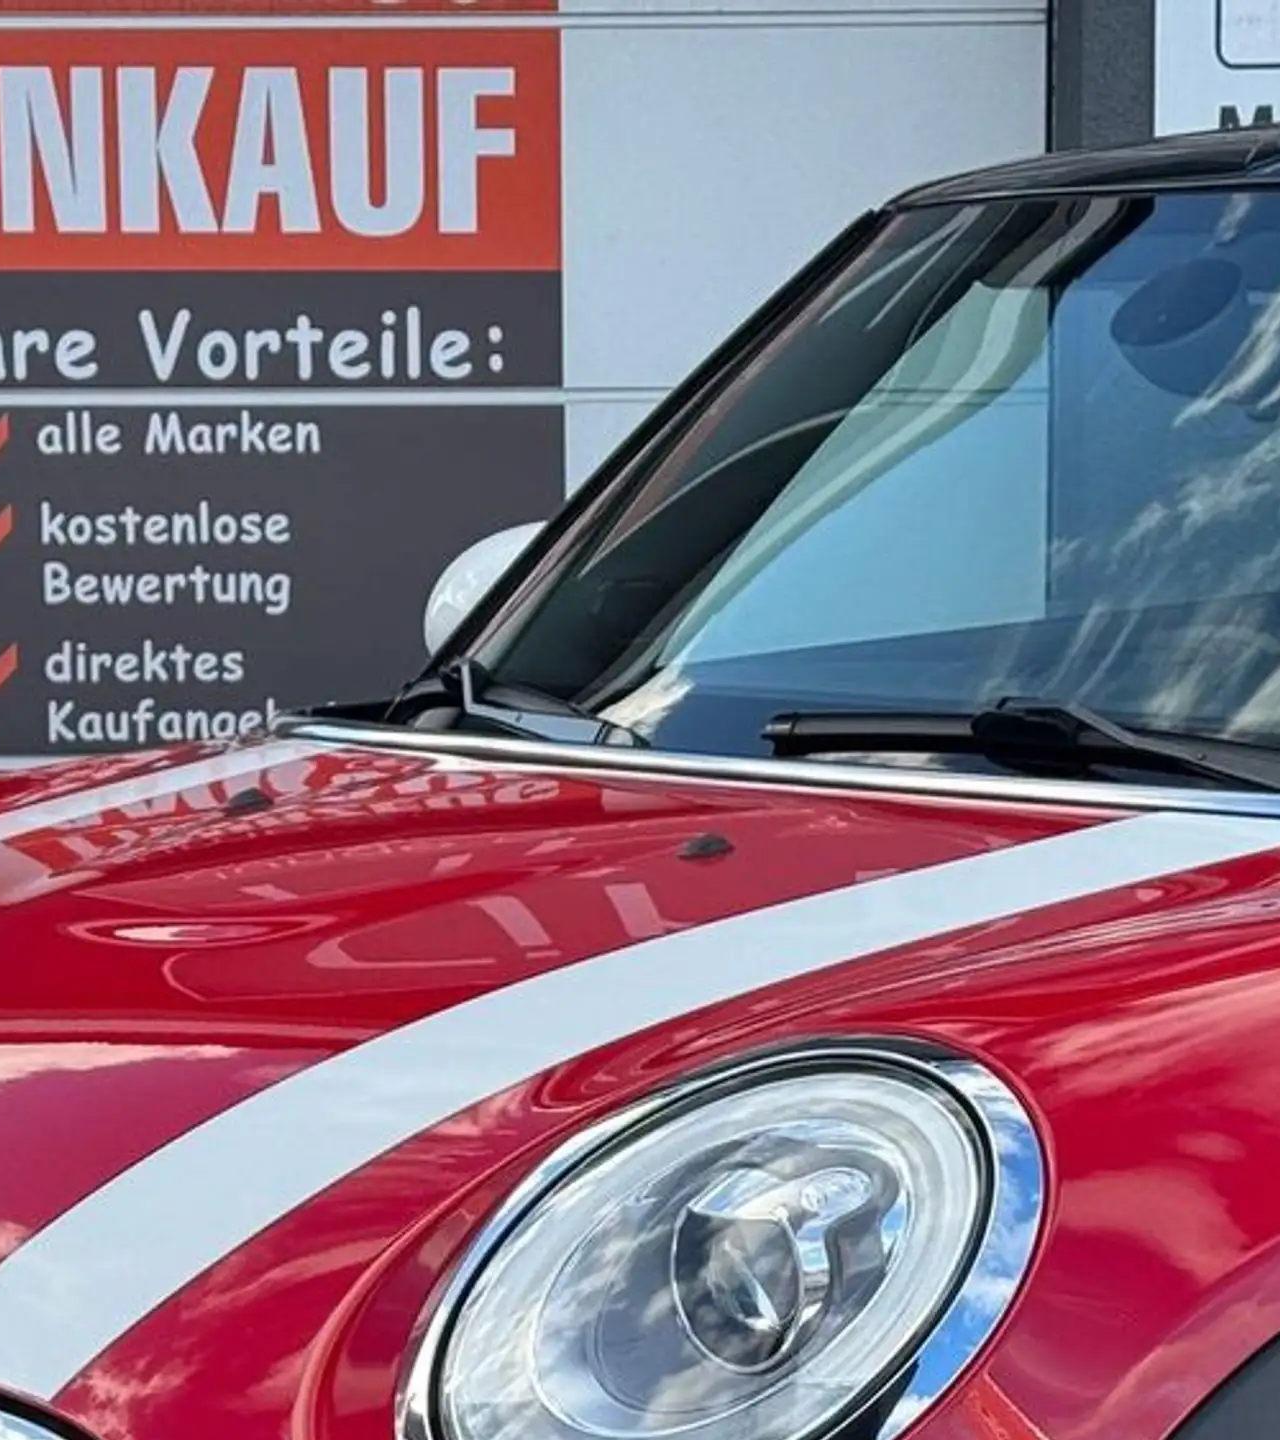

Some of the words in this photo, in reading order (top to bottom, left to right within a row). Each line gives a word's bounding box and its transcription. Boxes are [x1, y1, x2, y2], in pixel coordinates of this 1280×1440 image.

[138, 306, 505, 382] Vorteile:
[37, 411, 122, 456] alle
[144, 409, 322, 456] Marken
[40, 501, 291, 546] kostenlose
[43, 561, 291, 615] Bewertung
[44, 640, 245, 684] direktes
